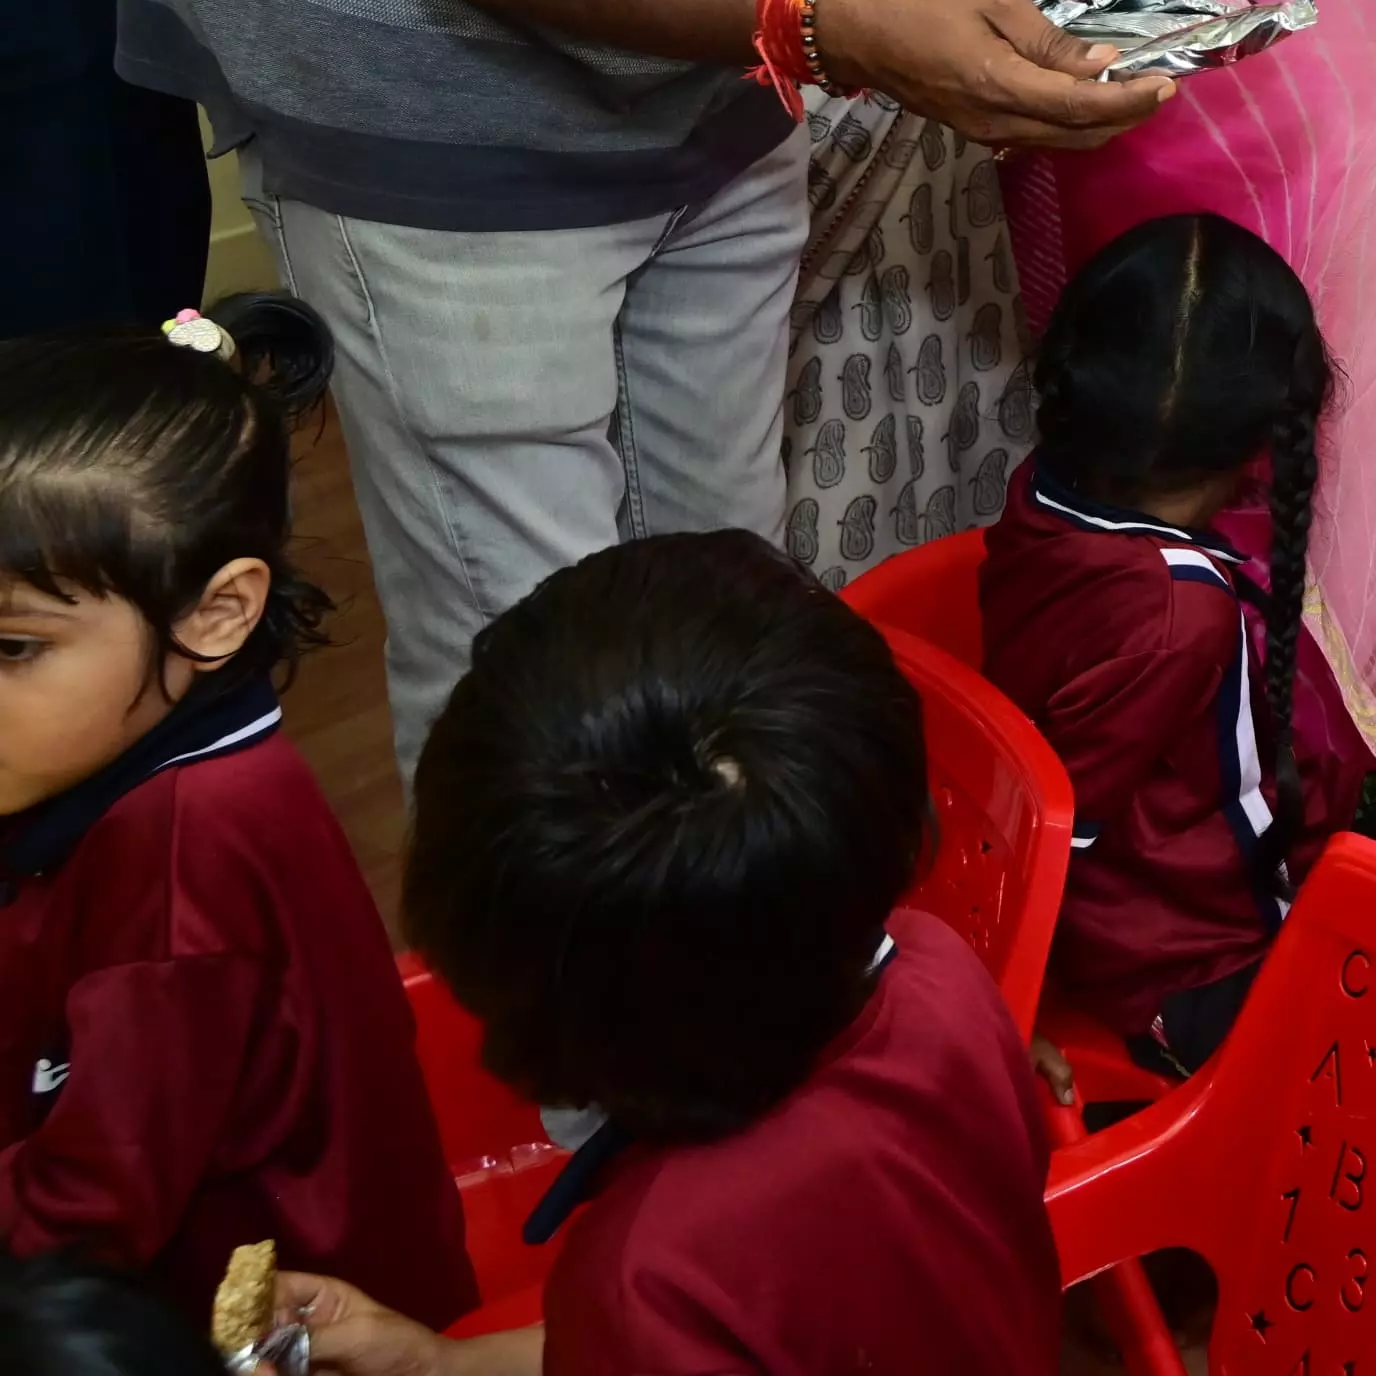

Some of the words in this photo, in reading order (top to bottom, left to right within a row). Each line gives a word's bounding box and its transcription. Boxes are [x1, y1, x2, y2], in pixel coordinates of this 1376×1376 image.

[1307, 1037, 1343, 1108] A
[1329, 1139, 1368, 1212] B
[1280, 1187, 1302, 1244] 1
[1339, 1247, 1368, 1313] 3
